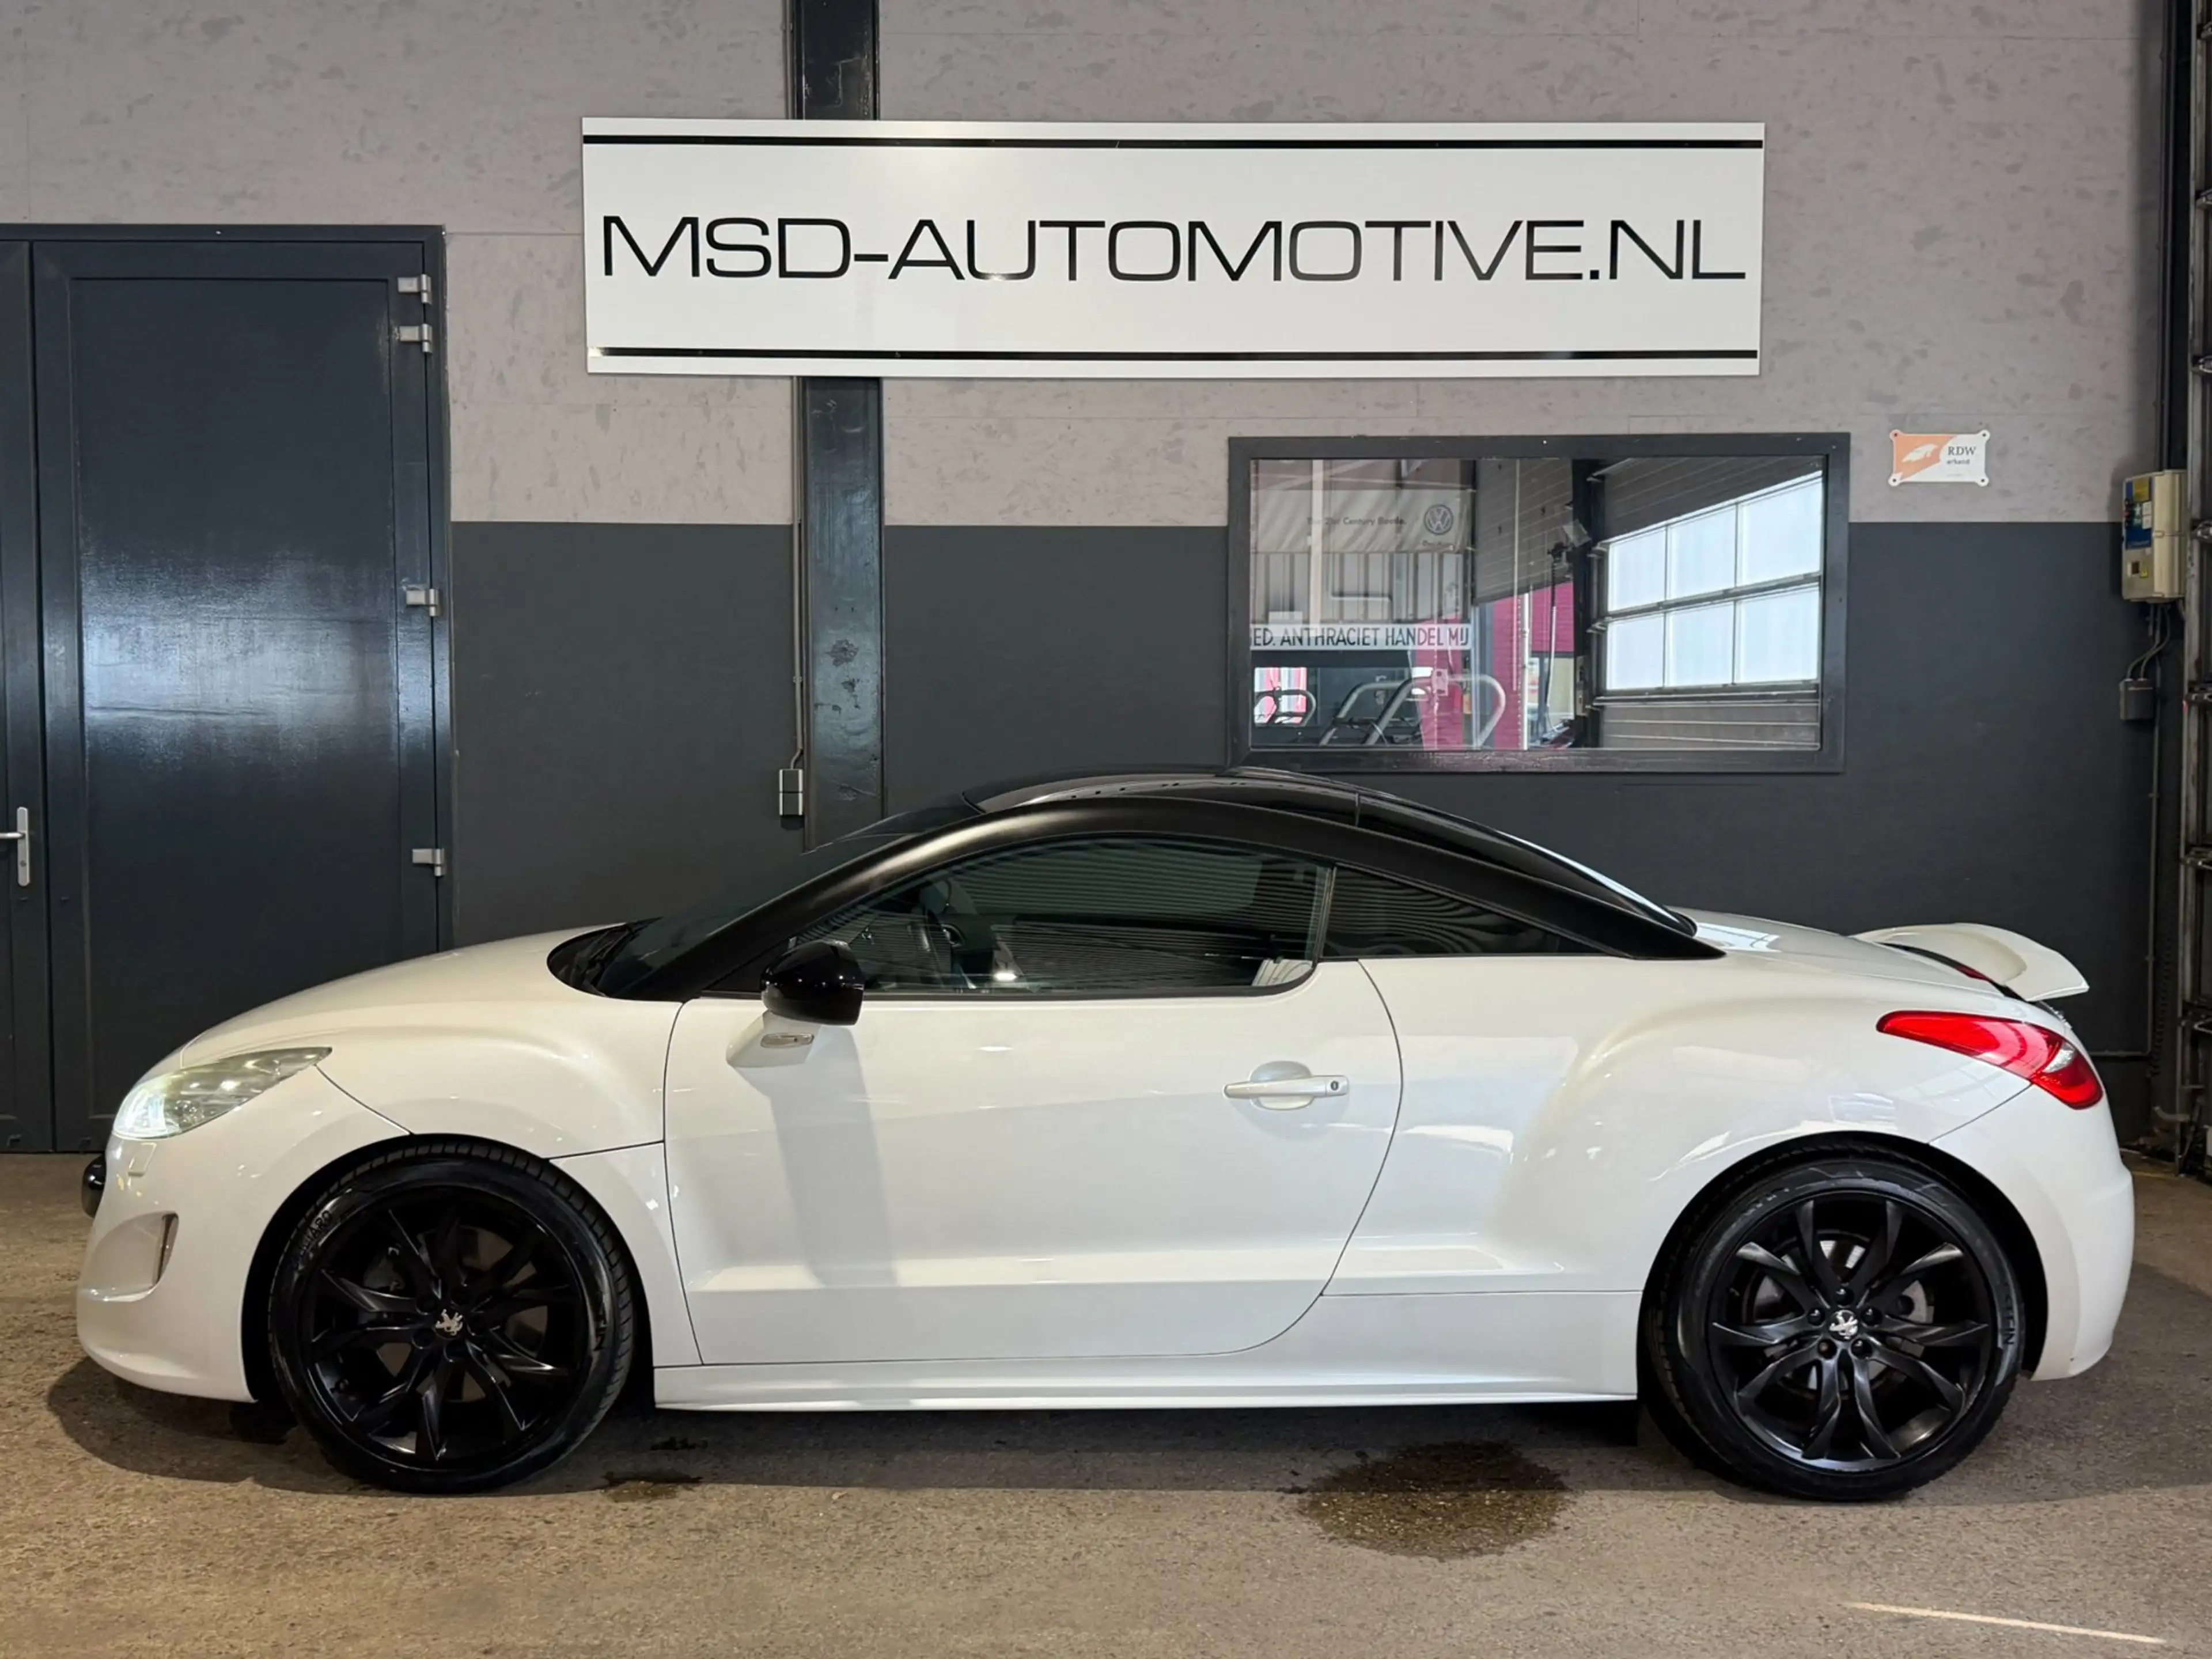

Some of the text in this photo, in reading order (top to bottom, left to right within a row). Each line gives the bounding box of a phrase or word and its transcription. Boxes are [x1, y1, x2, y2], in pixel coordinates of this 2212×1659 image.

[604, 215, 1746, 281] MSD-AUTOMOTIVE.NL
[1948, 446, 1977, 456] RDW
[1280, 628, 1380, 646] ANTHRACIET
[1385, 627, 1444, 646] HANDEL
